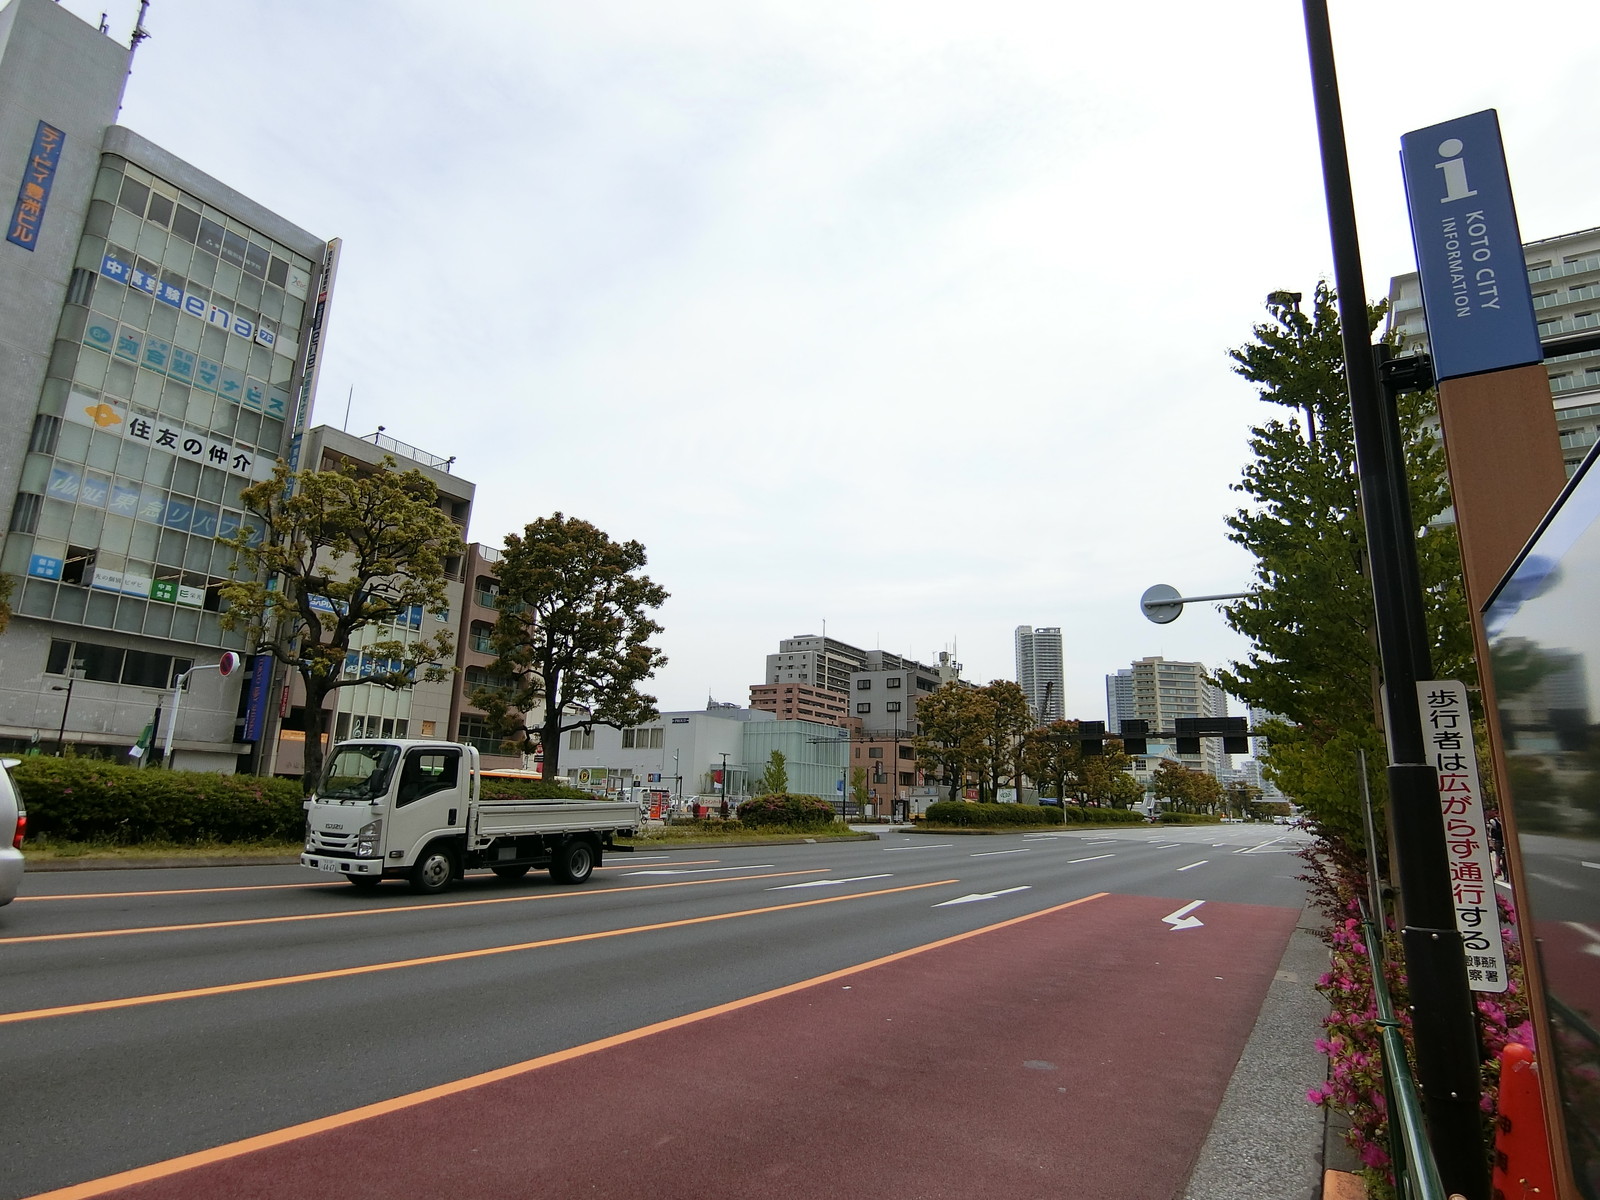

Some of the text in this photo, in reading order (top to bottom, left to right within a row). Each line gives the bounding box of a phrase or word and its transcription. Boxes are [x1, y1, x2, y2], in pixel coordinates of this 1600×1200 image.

[106, 260, 181, 303] 中高受験
[1442, 217, 1471, 317] INFORMATION
[1466, 210, 1500, 309] KOTO CITY
[185, 296, 252, 338] ena
[261, 330, 273, 344] 7F
[129, 418, 252, 472] 住友の仲介
[1427, 689, 1491, 951] 歩行者は広がらず通行する
